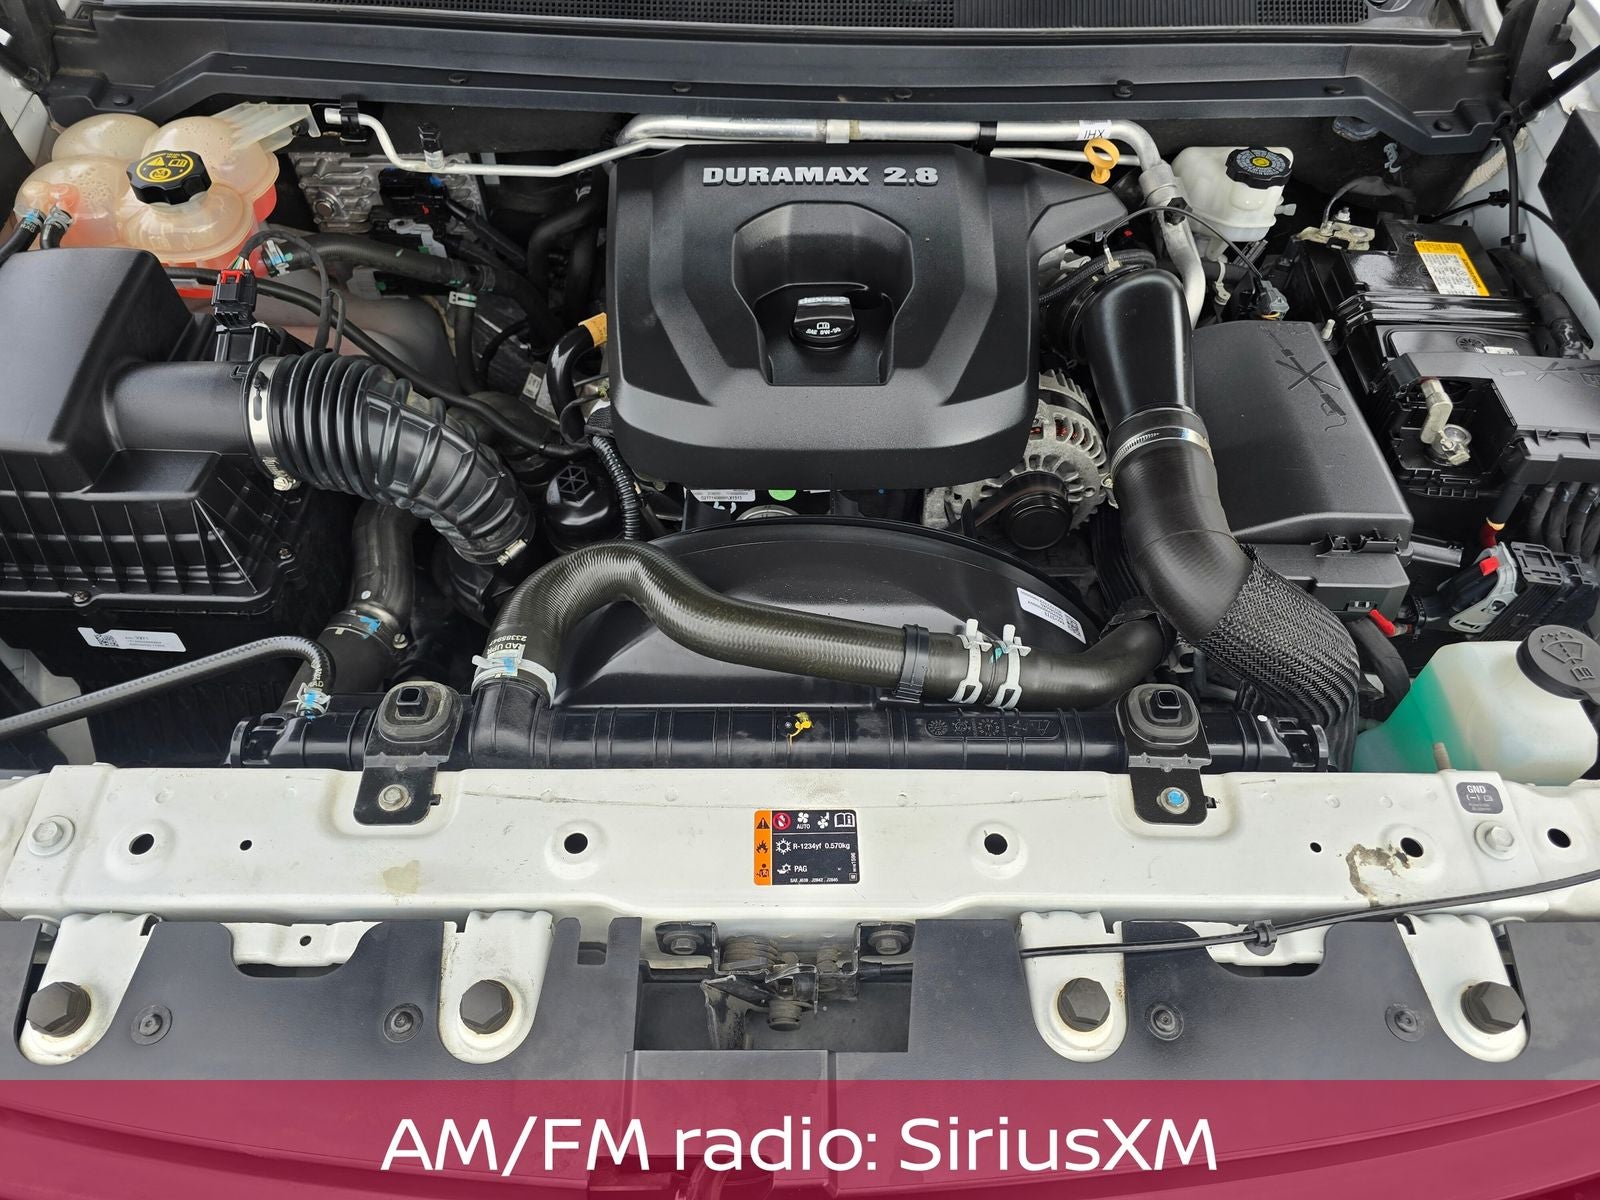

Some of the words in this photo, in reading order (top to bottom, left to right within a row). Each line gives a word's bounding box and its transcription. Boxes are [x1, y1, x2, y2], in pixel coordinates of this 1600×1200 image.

[702, 167, 869, 186] DURAMAX
[883, 167, 939, 186] 2.8
[1466, 784, 1487, 794] GND
[792, 843, 822, 851] R-1234yf
[824, 842, 851, 850] 0.570kg
[794, 865, 808, 873] PAG
